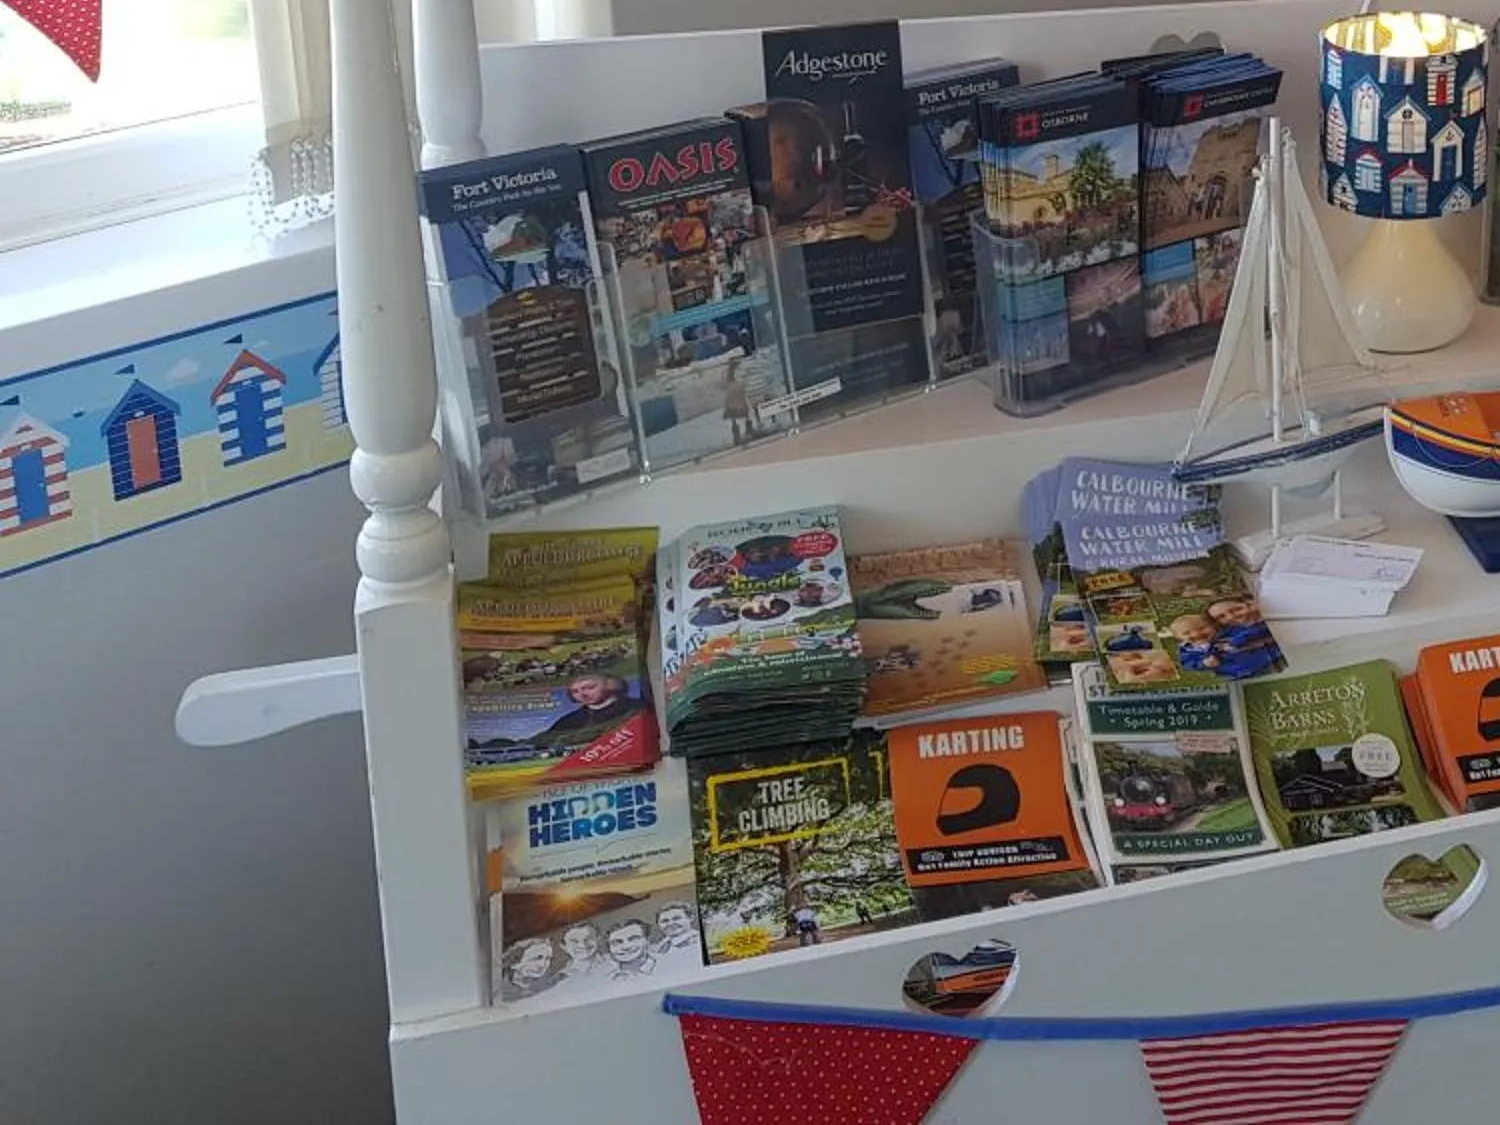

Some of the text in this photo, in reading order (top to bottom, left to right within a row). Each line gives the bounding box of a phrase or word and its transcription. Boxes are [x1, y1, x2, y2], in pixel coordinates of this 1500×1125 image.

[775, 49, 888, 82] Adgestone
[918, 78, 999, 106] Fort Victoria
[609, 137, 736, 192] OASIS
[452, 168, 557, 200] Fort Victoria
[1077, 471, 1191, 501] CALBOURNE
[1071, 489, 1135, 514] WATER
[1080, 536, 1204, 556] WATER MILL
[1081, 521, 1197, 541] CALBOURNE
[1269, 679, 1366, 713] ARRETON
[1124, 714, 1198, 729] Spring 2019
[1268, 709, 1337, 731] BARNS
[918, 725, 1025, 759] KARTING
[528, 782, 657, 825] HIDDEN
[757, 776, 804, 804] TREE
[530, 805, 657, 848] HEROES
[739, 798, 831, 832] CLIMBING
[1136, 837, 1190, 850] SPECIAL
[1194, 835, 1222, 848] DAY
[1225, 831, 1257, 845] OUT
